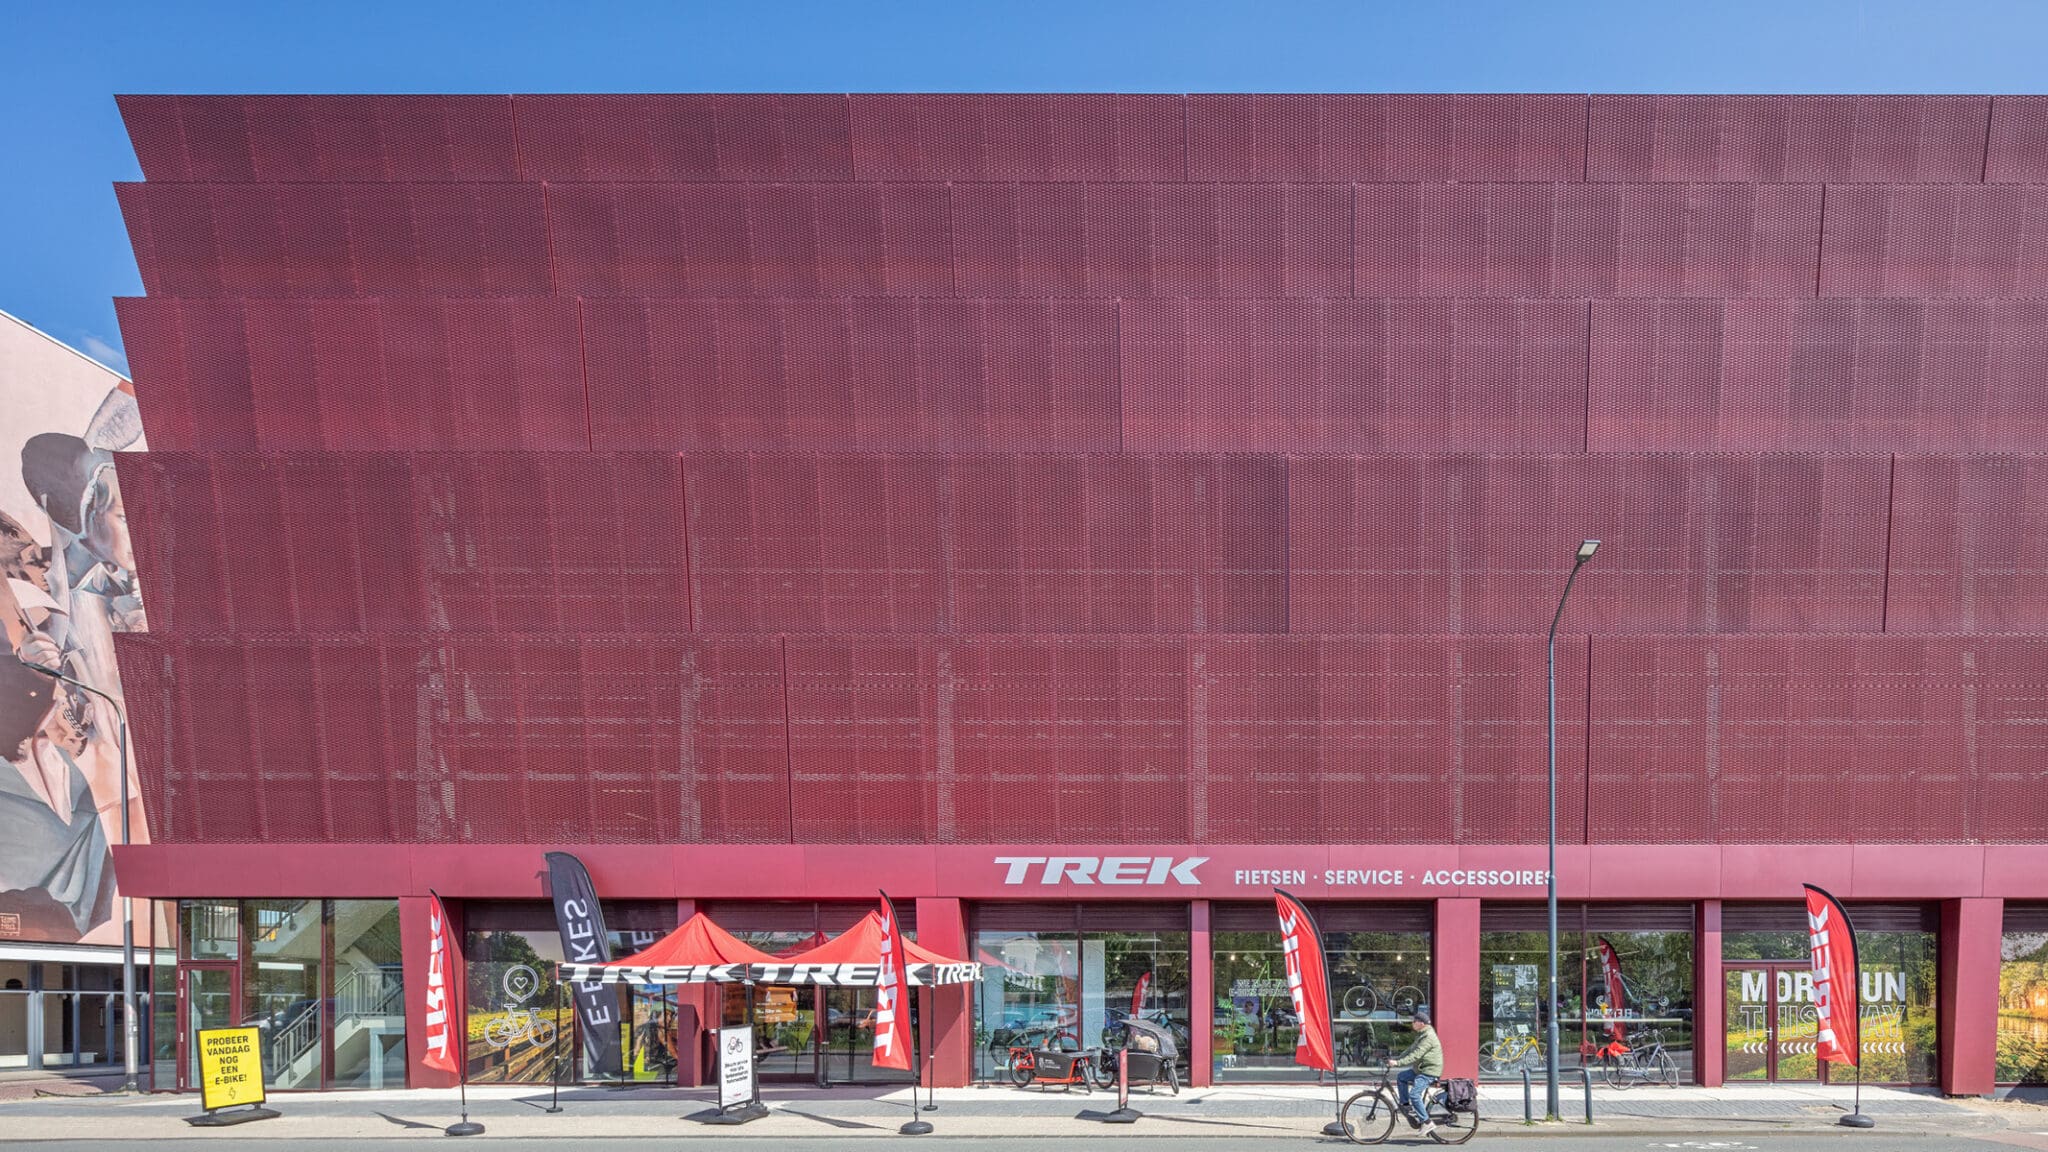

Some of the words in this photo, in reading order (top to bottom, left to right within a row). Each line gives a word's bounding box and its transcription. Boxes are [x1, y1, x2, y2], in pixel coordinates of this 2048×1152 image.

[994, 857, 1210, 885] TREK
[1235, 870, 1306, 885] FIETSEN
[1325, 870, 1403, 885] SERVICE
[561, 962, 741, 984] TREK
[936, 962, 982, 984] TREK
[1742, 972, 1815, 1002] MOR
[1862, 972, 1906, 1002] UN
[1740, 1005, 1819, 1038] THIS
[1860, 1004, 1906, 1038] AY
[207, 1035, 249, 1046] PROBEER
[207, 1045, 250, 1056] VANDAAG
[219, 1056, 239, 1064] NOG
[221, 1066, 238, 1075] EEN
[215, 1074, 247, 1085] E-BIKE!
